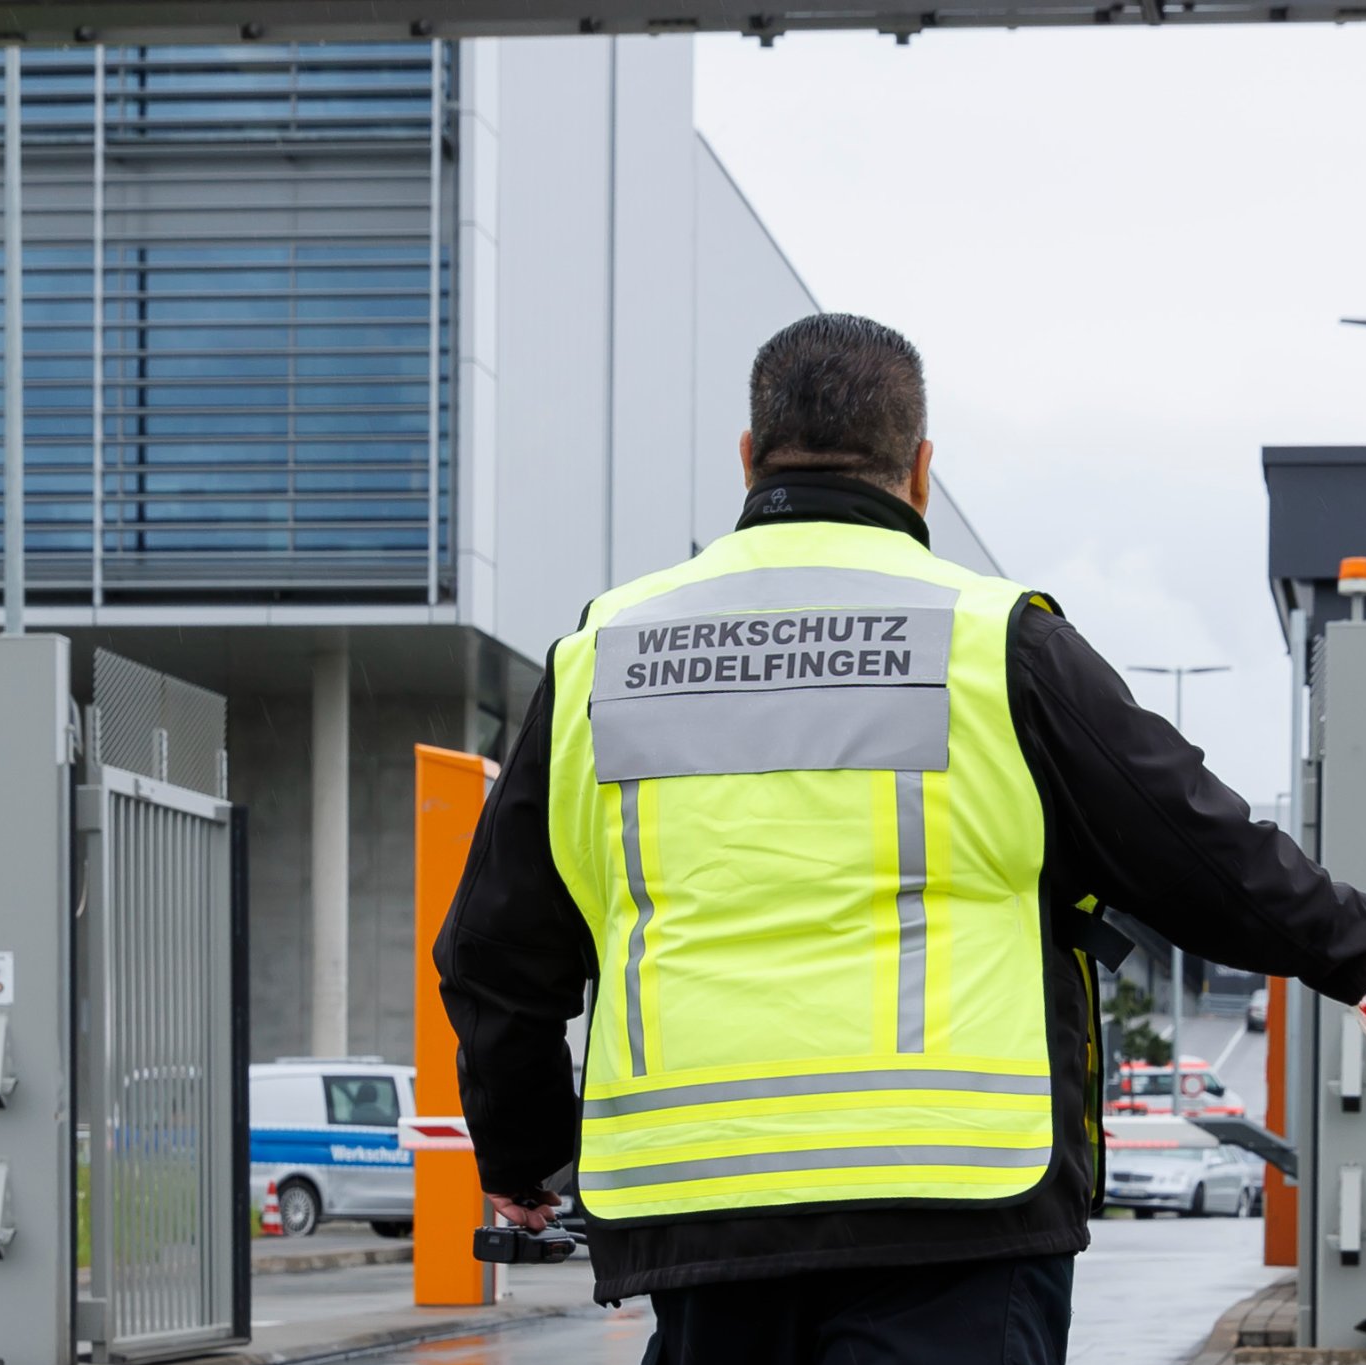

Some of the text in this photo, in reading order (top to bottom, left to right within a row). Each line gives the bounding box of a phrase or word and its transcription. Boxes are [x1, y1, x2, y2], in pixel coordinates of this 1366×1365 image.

[762, 504, 793, 514] ELKA
[637, 615, 909, 655] WERKSCHUTZ
[624, 649, 912, 689] SINDELFINGEN
[330, 1144, 411, 1165] Werkschutz
